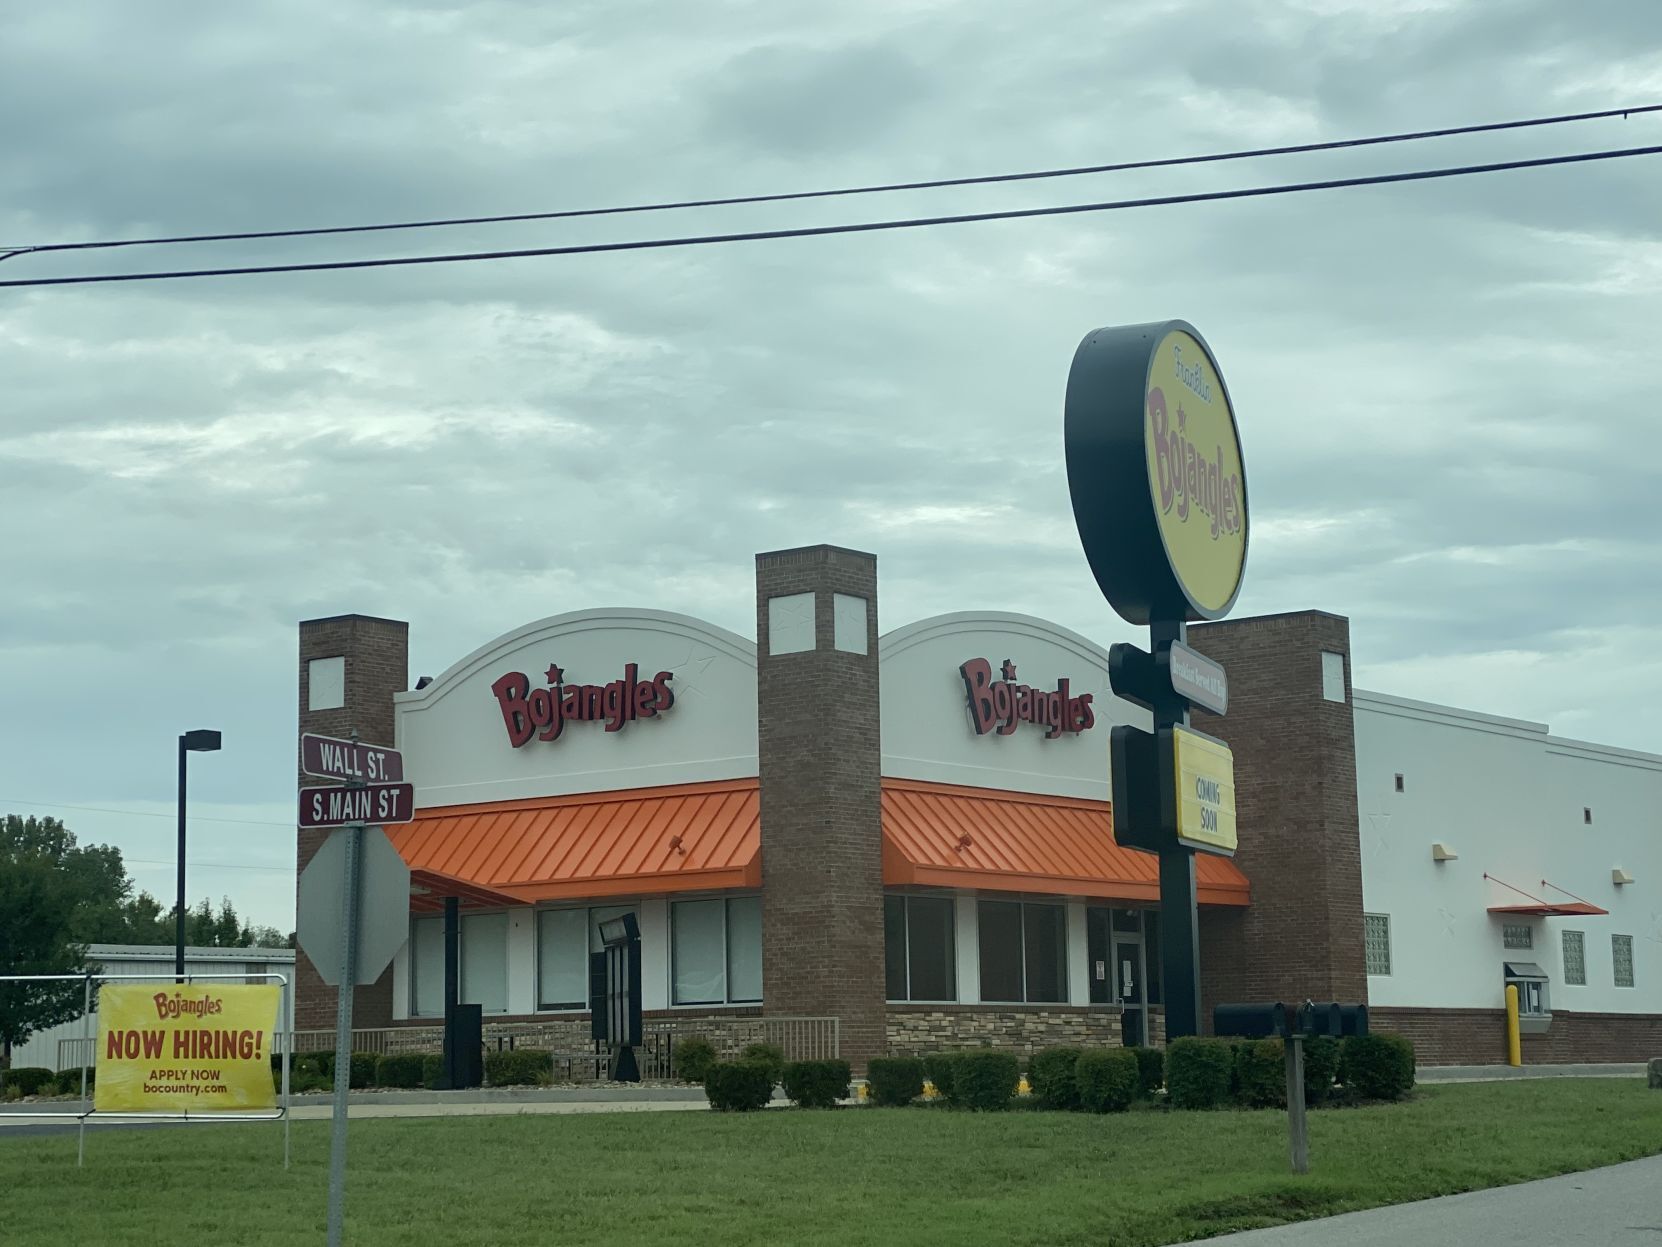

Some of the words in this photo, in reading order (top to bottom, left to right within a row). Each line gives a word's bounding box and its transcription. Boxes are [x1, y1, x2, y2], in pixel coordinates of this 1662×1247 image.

[1147, 386, 1241, 540] Bojangles
[491, 663, 675, 748] Bojangles
[959, 657, 1095, 739] Bojangles
[320, 743, 362, 776] WALL
[367, 751, 389, 781] ST.
[378, 789, 400, 818] ST
[1196, 777, 1220, 806] COMING
[1201, 806, 1218, 833] SOON
[153, 992, 223, 1020] Bojangles
[107, 1029, 166, 1060] NOW
[173, 1029, 263, 1061] HIRING!
[143, 1082, 227, 1097] bocountry.com
[149, 1069, 187, 1081] APPLY
[190, 1069, 221, 1081] NOW
